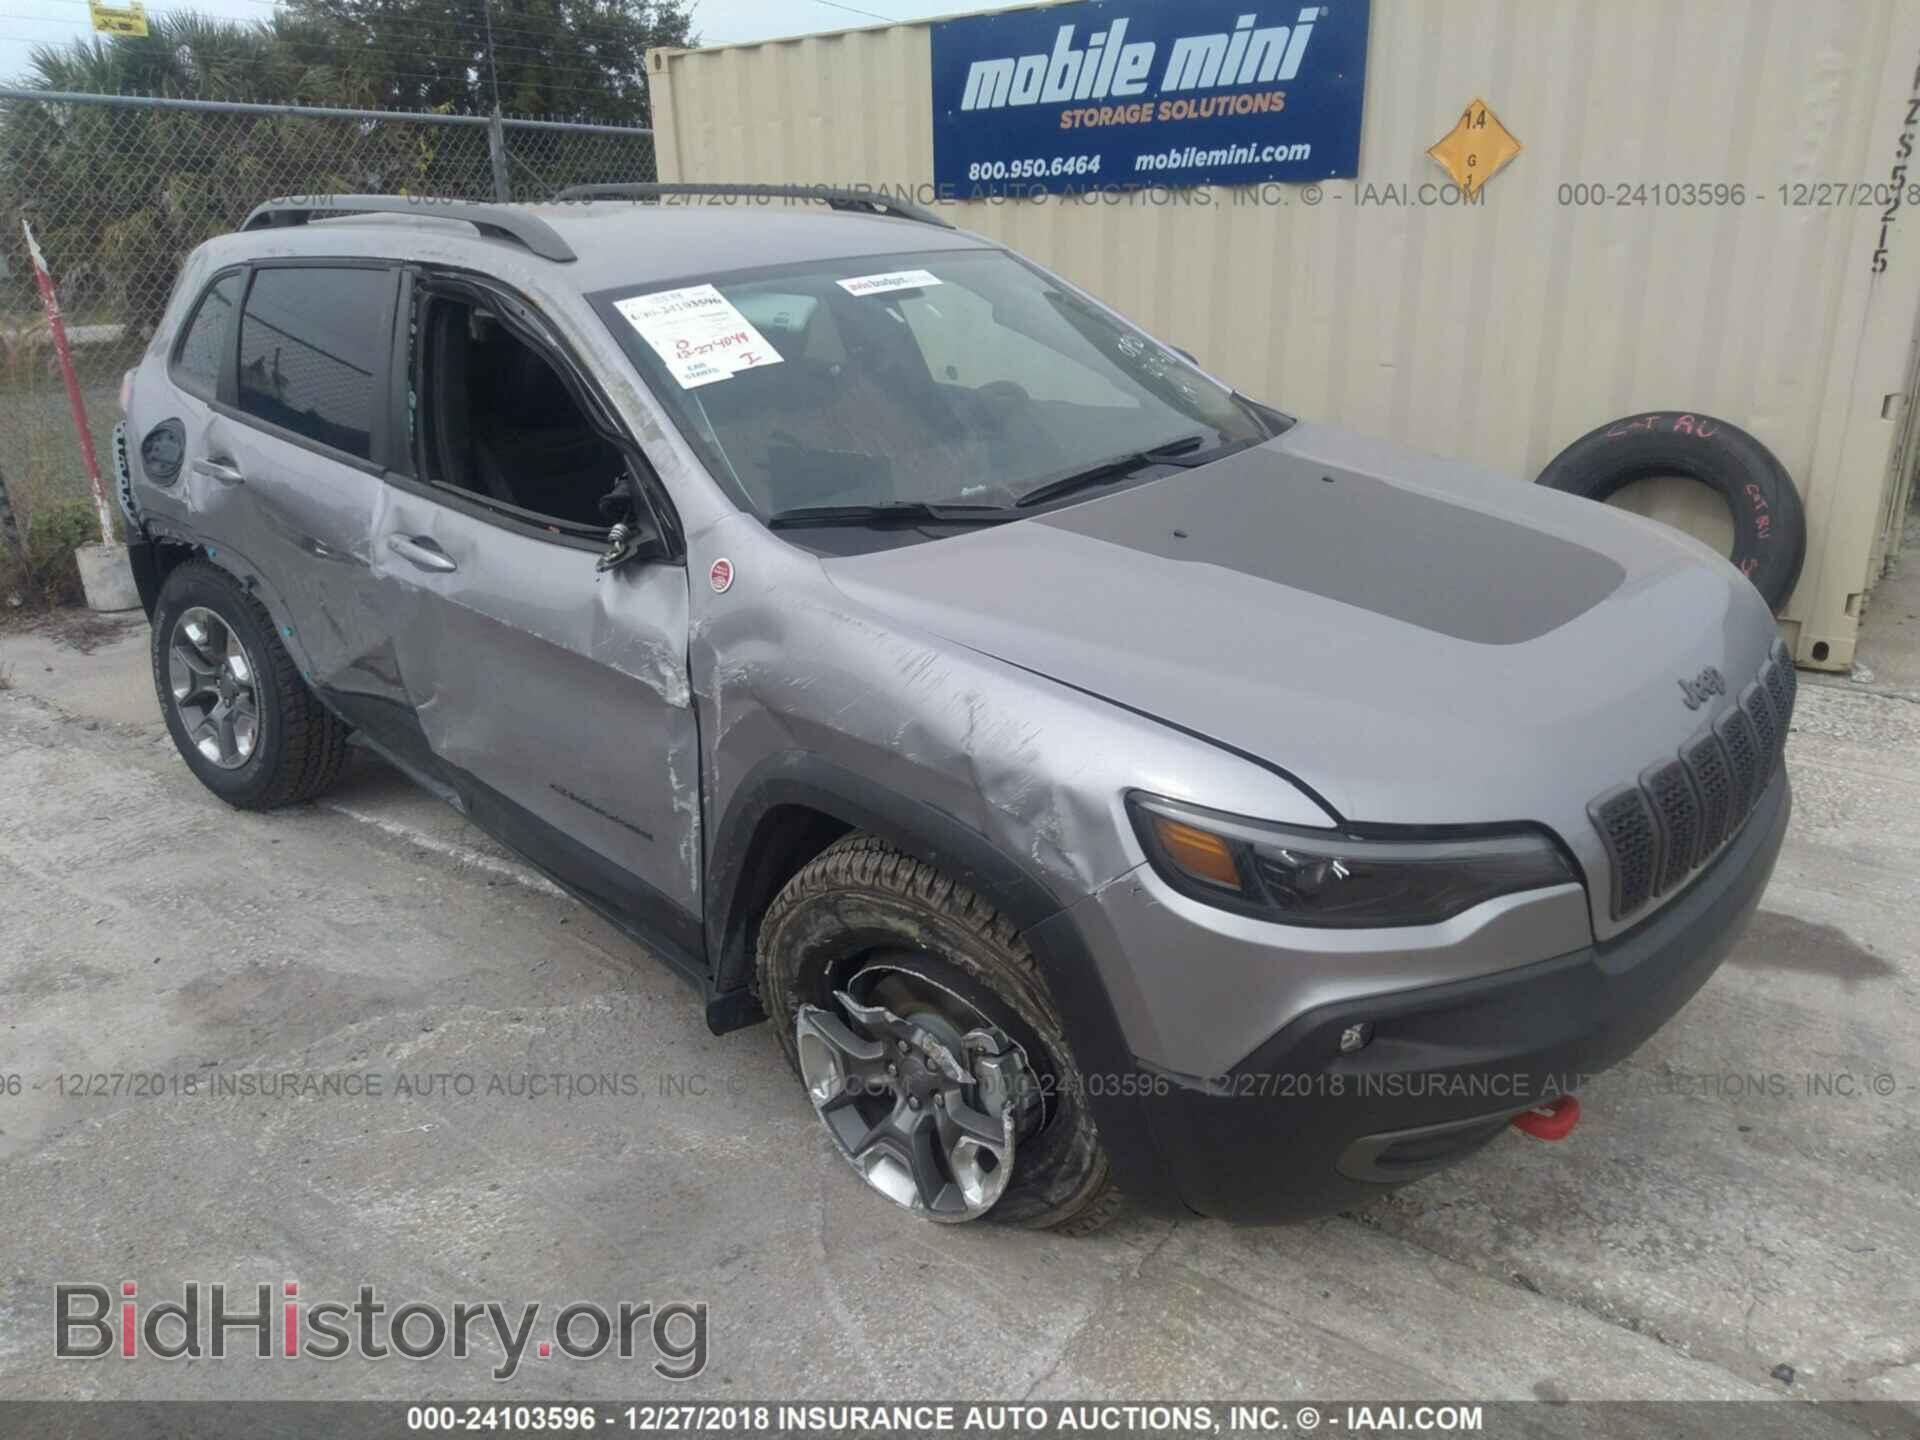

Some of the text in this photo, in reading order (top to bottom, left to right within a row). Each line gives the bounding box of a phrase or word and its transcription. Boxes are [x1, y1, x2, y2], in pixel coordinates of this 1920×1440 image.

[961, 7, 1320, 110] mobile mini
[1060, 91, 1286, 129] STORAGE SOLUTIONS
[1464, 110, 1487, 130] 1.4
[968, 141, 1312, 181] 800.950.6464 mobilemini.com
[1467, 154, 1477, 168] G
